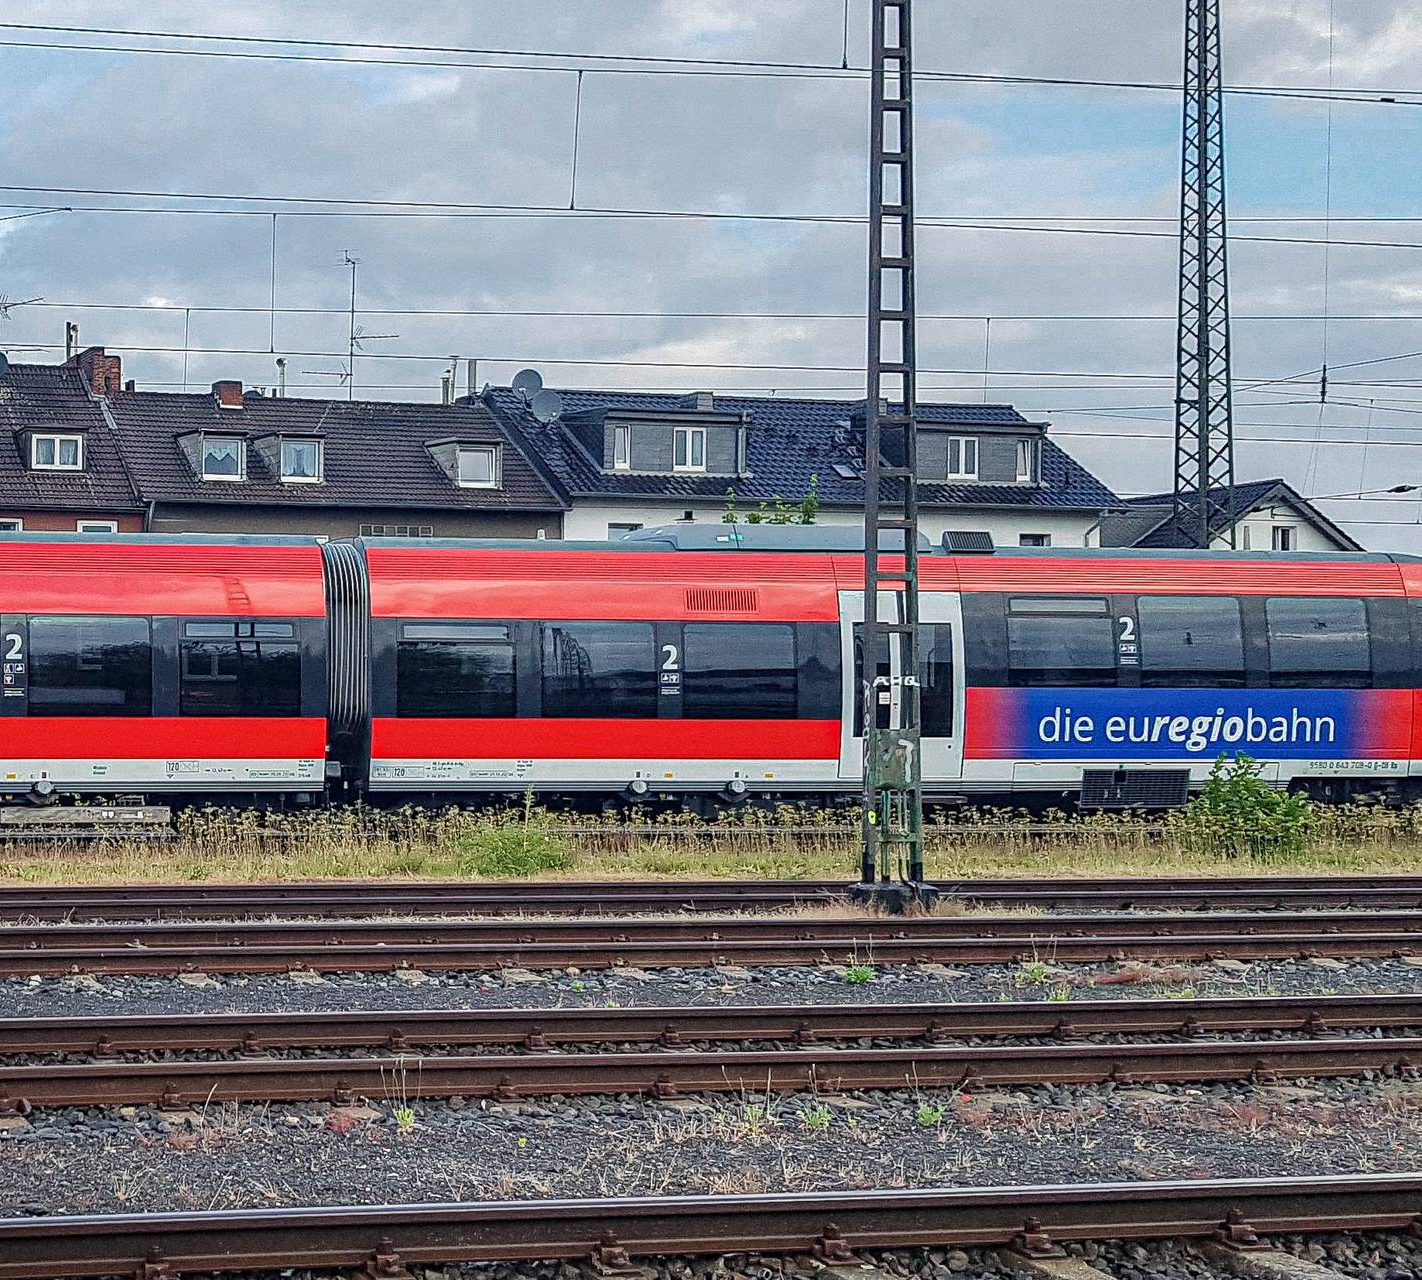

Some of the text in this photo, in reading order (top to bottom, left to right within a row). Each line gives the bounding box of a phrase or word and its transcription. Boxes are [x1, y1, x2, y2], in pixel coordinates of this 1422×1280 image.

[1119, 616, 1136, 641] 2
[5, 633, 23, 660] 2
[662, 644, 678, 670] 2
[1038, 706, 1335, 752] die euregiobahn
[167, 762, 180, 771] 120
[393, 767, 405, 777] 120
